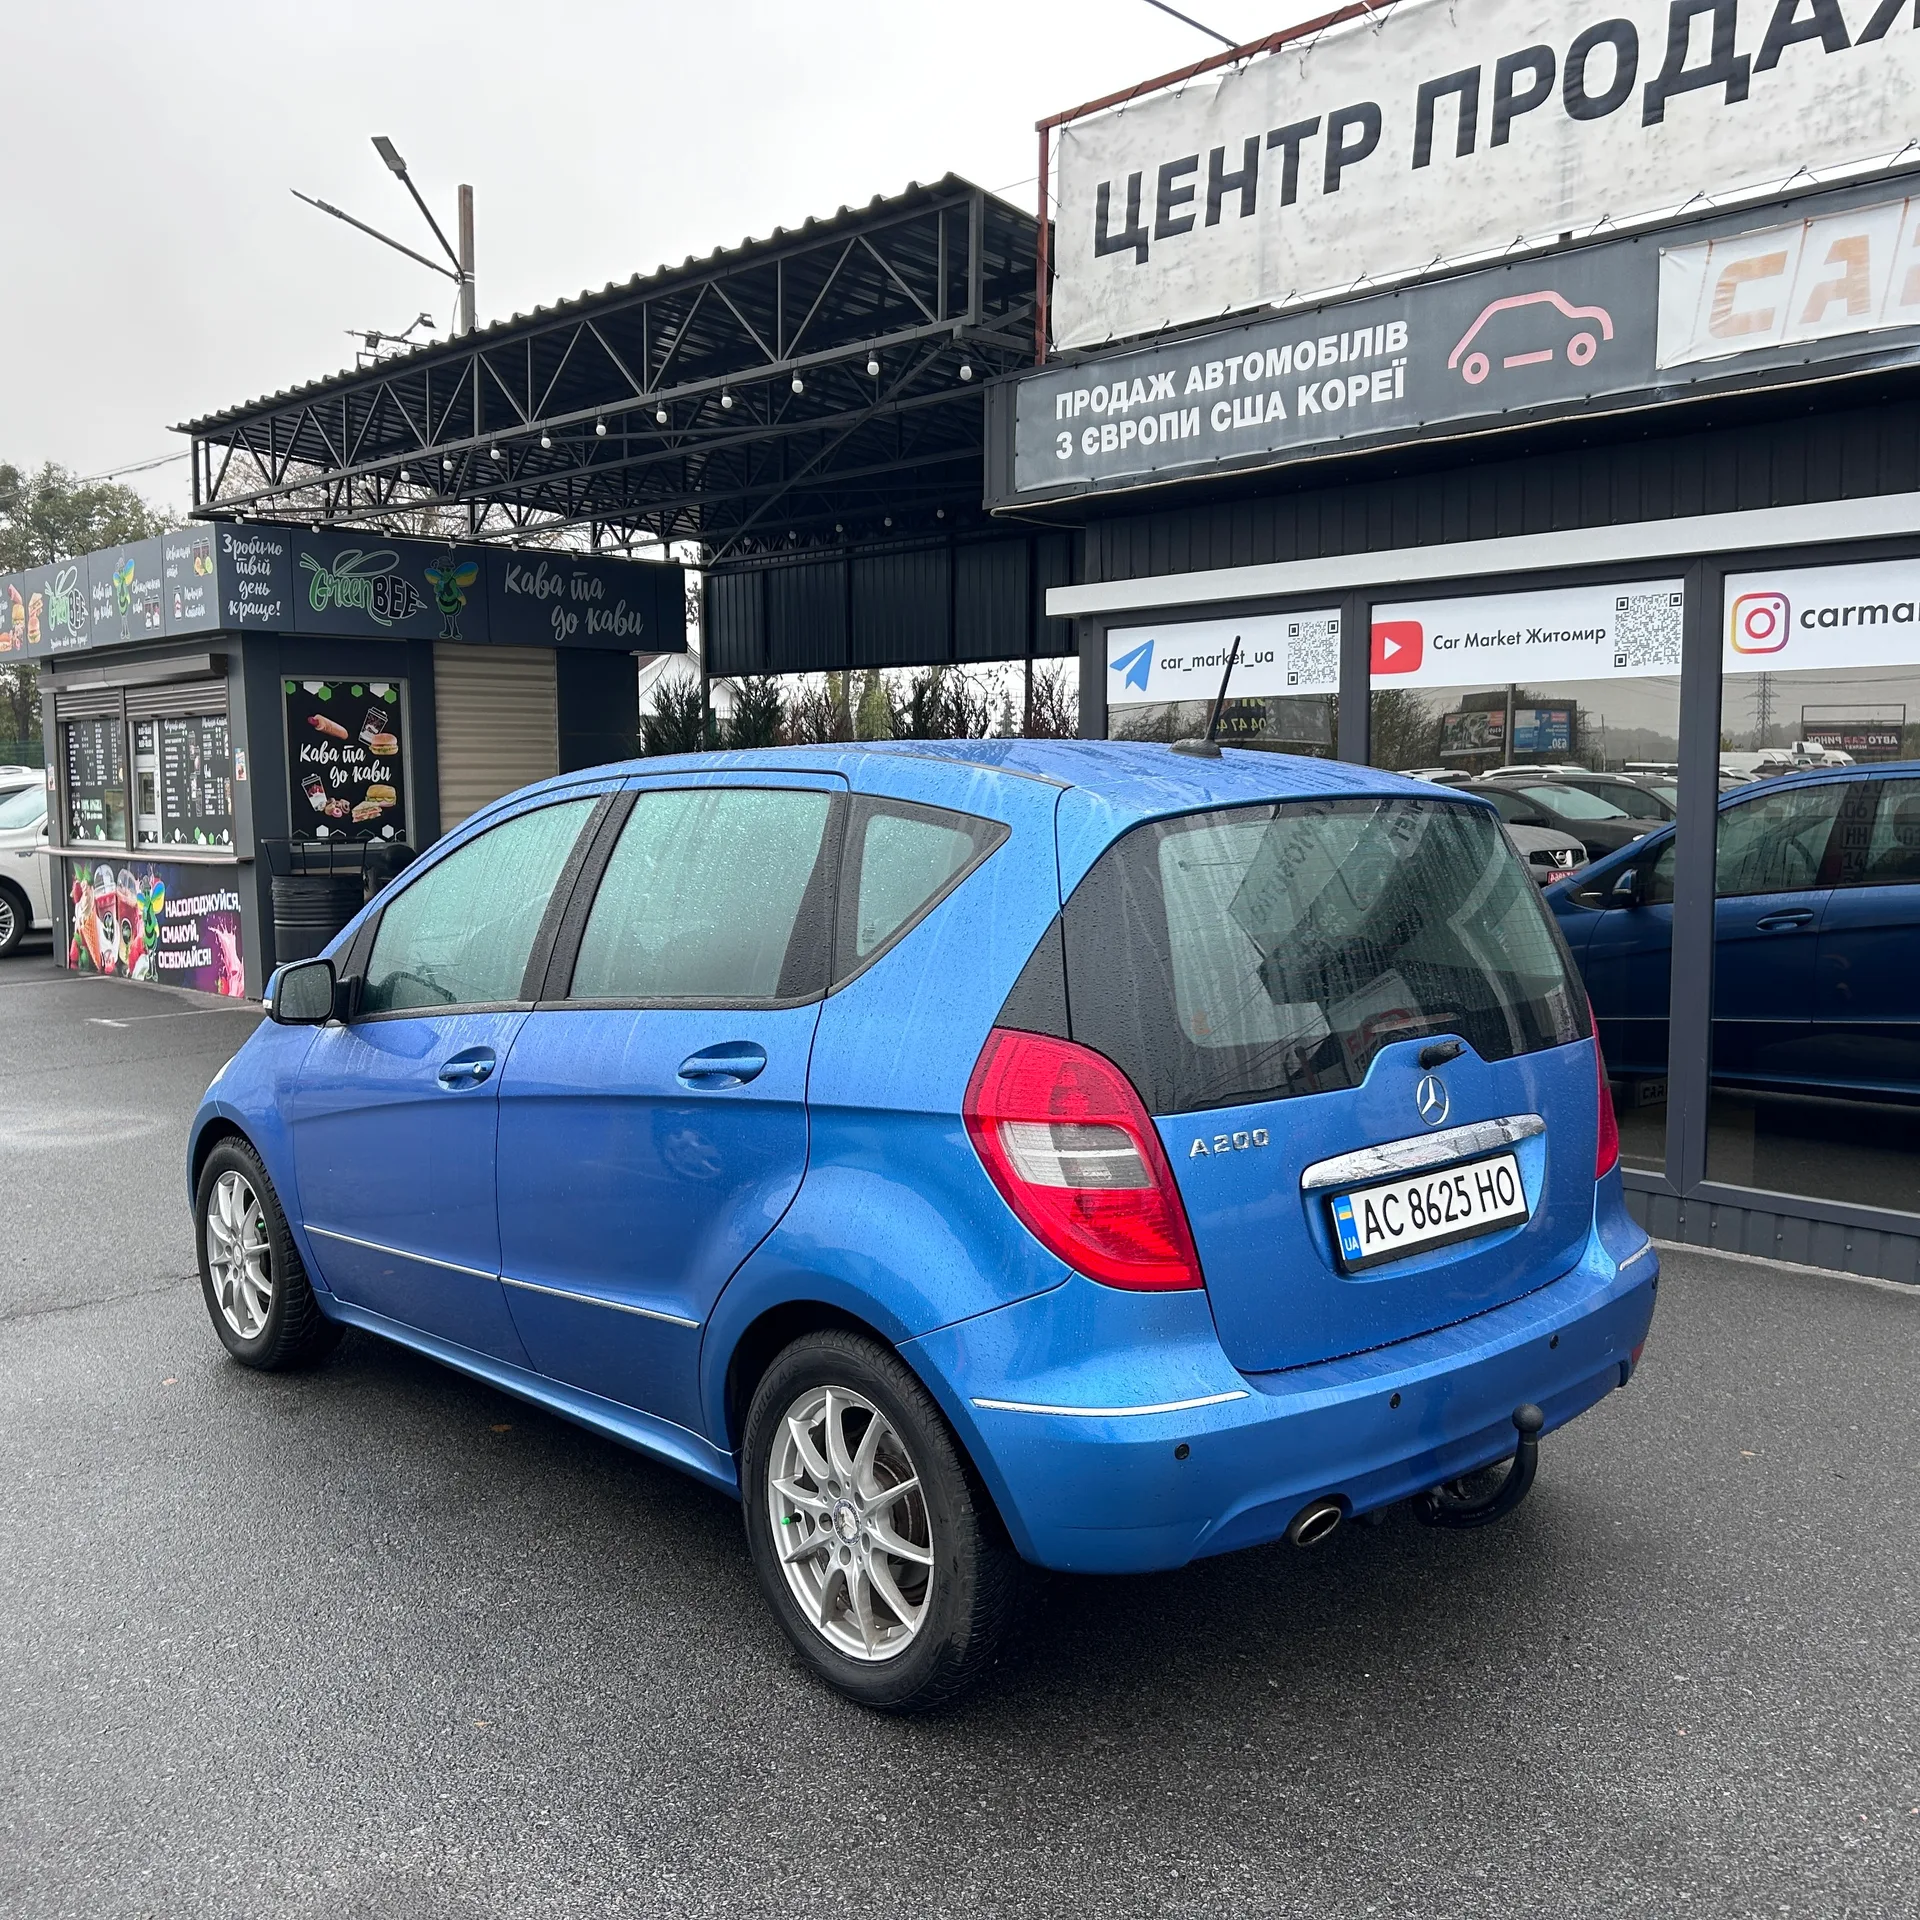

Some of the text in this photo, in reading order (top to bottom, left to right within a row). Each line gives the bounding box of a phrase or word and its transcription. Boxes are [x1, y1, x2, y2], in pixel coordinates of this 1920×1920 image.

[1094, 101, 1382, 265] ЦЕНТР
[1055, 320, 1409, 420] ПРОДАЖ АВТОМОБІЛІВ
[1055, 356, 1407, 460] З ЄВРОПИ США КОРЕЇ
[222, 533, 283, 560] Зробимо
[236, 555, 271, 575] твій
[238, 580, 270, 601] день
[504, 561, 605, 601] Кава та
[228, 600, 281, 623] краще!
[551, 599, 644, 641] до кави
[1800, 602, 1920, 629] carma
[1433, 625, 1606, 651] Car Market Житомир
[1160, 647, 1274, 673] car_market_ua
[299, 740, 367, 765] Кава та
[329, 759, 392, 788] до кави
[165, 888, 241, 918] НАСОЛОДЖУЙСЯ,
[161, 919, 199, 944] СМАКУЙ,
[158, 945, 212, 969] ОСВІЖАЙСЯ!
[1364, 1165, 1515, 1244] AC 8625 HO
[1344, 1238, 1361, 1252] UA
